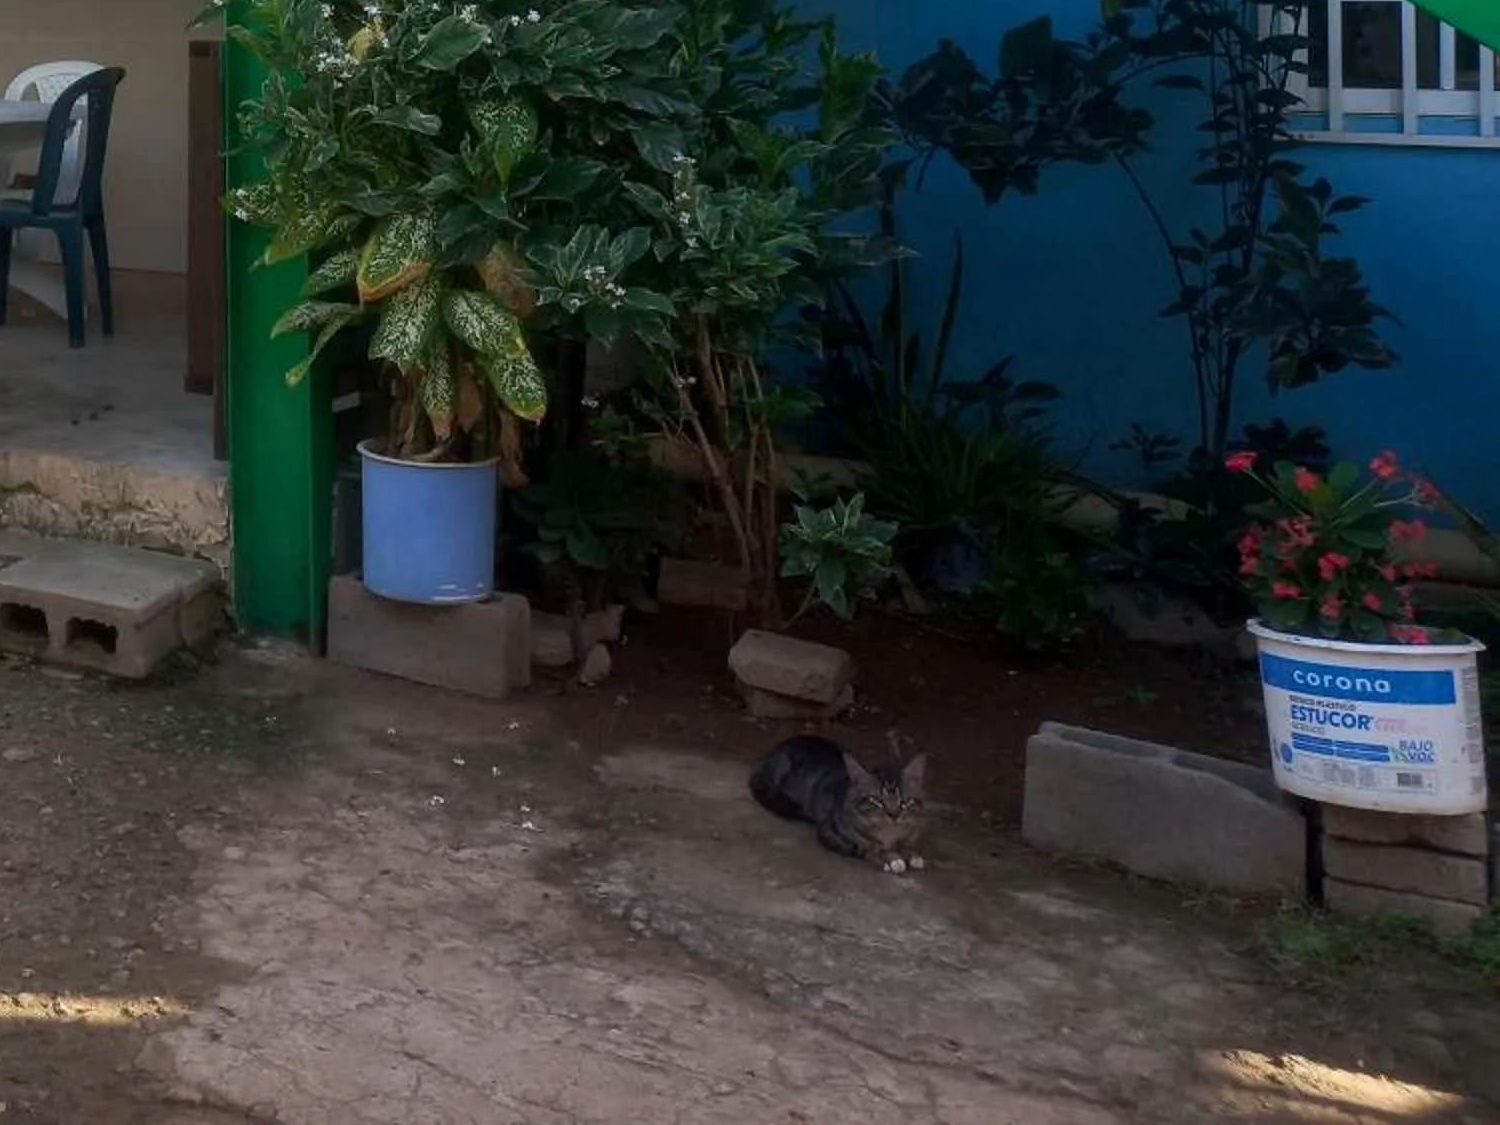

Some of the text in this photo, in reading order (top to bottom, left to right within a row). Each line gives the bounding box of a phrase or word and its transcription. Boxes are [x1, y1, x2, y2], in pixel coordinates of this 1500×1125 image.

[1292, 669, 1392, 693] corona
[1291, 704, 1371, 731] ESTUCOR
[1399, 739, 1433, 752] BAJO
